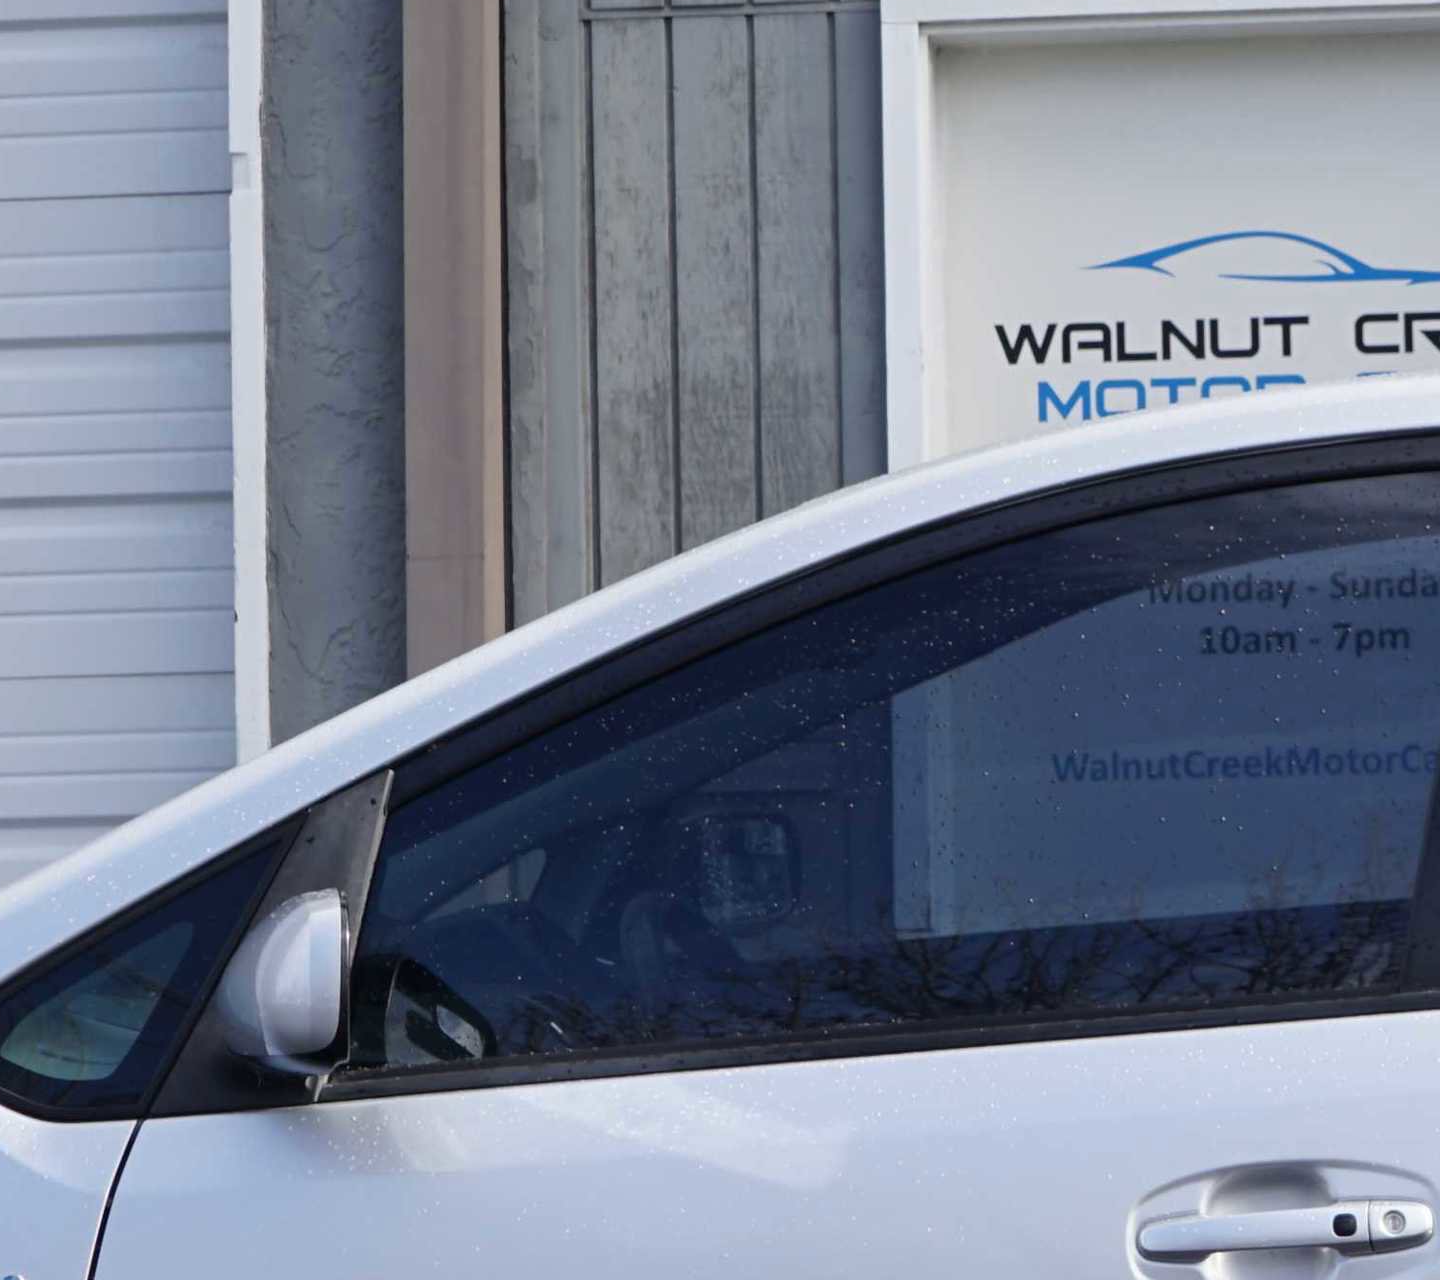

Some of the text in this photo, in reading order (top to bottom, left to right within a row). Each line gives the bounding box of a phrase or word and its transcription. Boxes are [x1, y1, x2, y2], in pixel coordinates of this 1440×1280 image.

[994, 315, 1310, 365] WALNUT
[1148, 573, 1296, 609] Monday
[1198, 624, 1297, 656] 10am
[1331, 621, 1411, 659] 7pm
